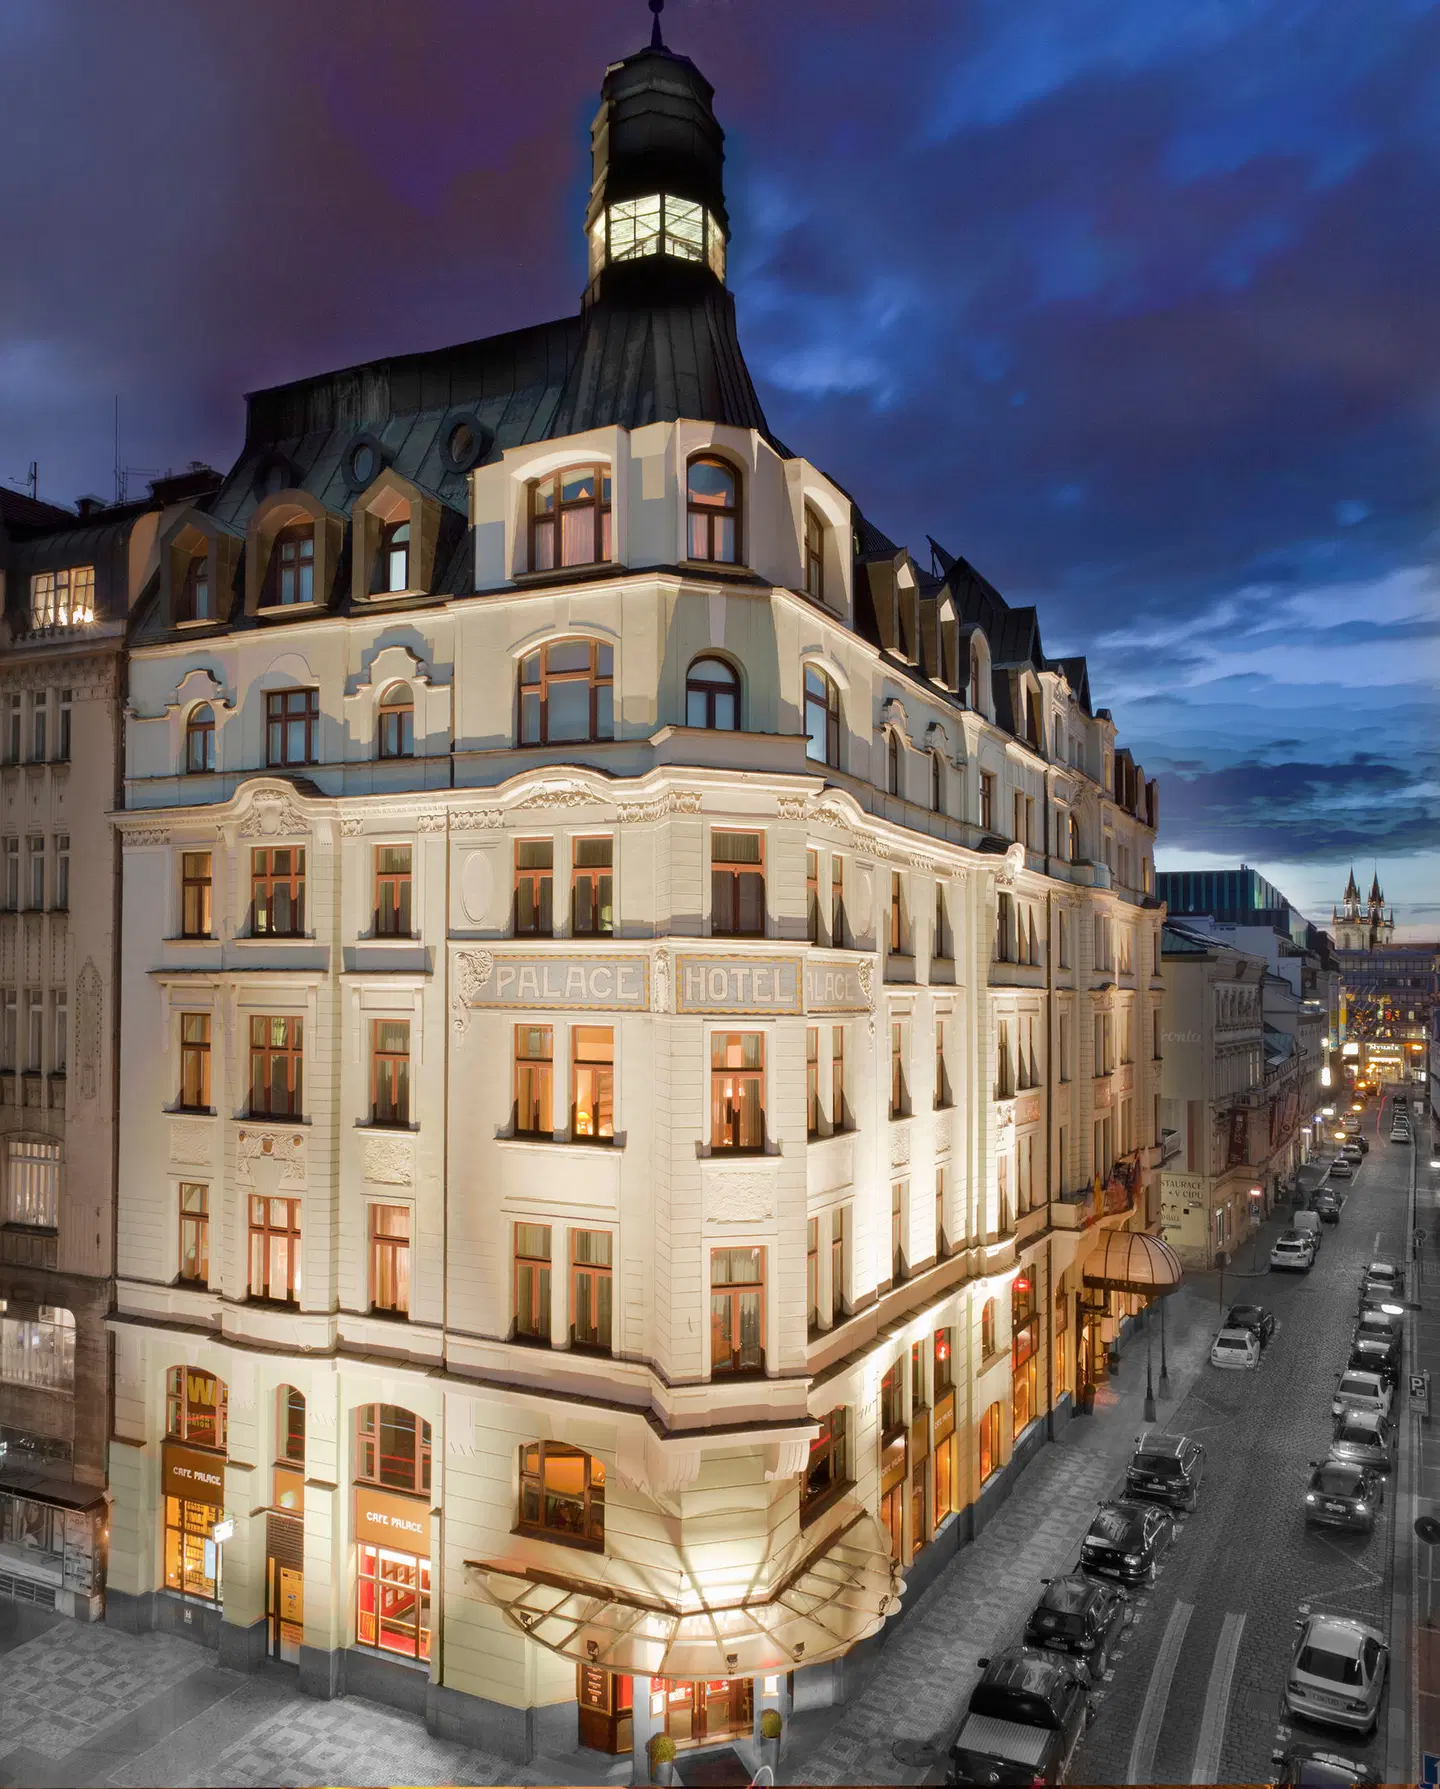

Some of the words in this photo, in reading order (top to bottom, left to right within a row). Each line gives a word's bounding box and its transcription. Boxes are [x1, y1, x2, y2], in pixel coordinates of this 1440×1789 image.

[495, 965, 639, 1000] PALACE
[685, 966, 795, 1002] HOTEL
[806, 971, 855, 1001] ALACE
[1160, 1180, 1204, 1190] STAURACE
[1411, 1377, 1423, 1390] P
[193, 1471, 221, 1486] PALACE
[366, 1511, 389, 1526] CAFE
[391, 1516, 423, 1533] PALACE
